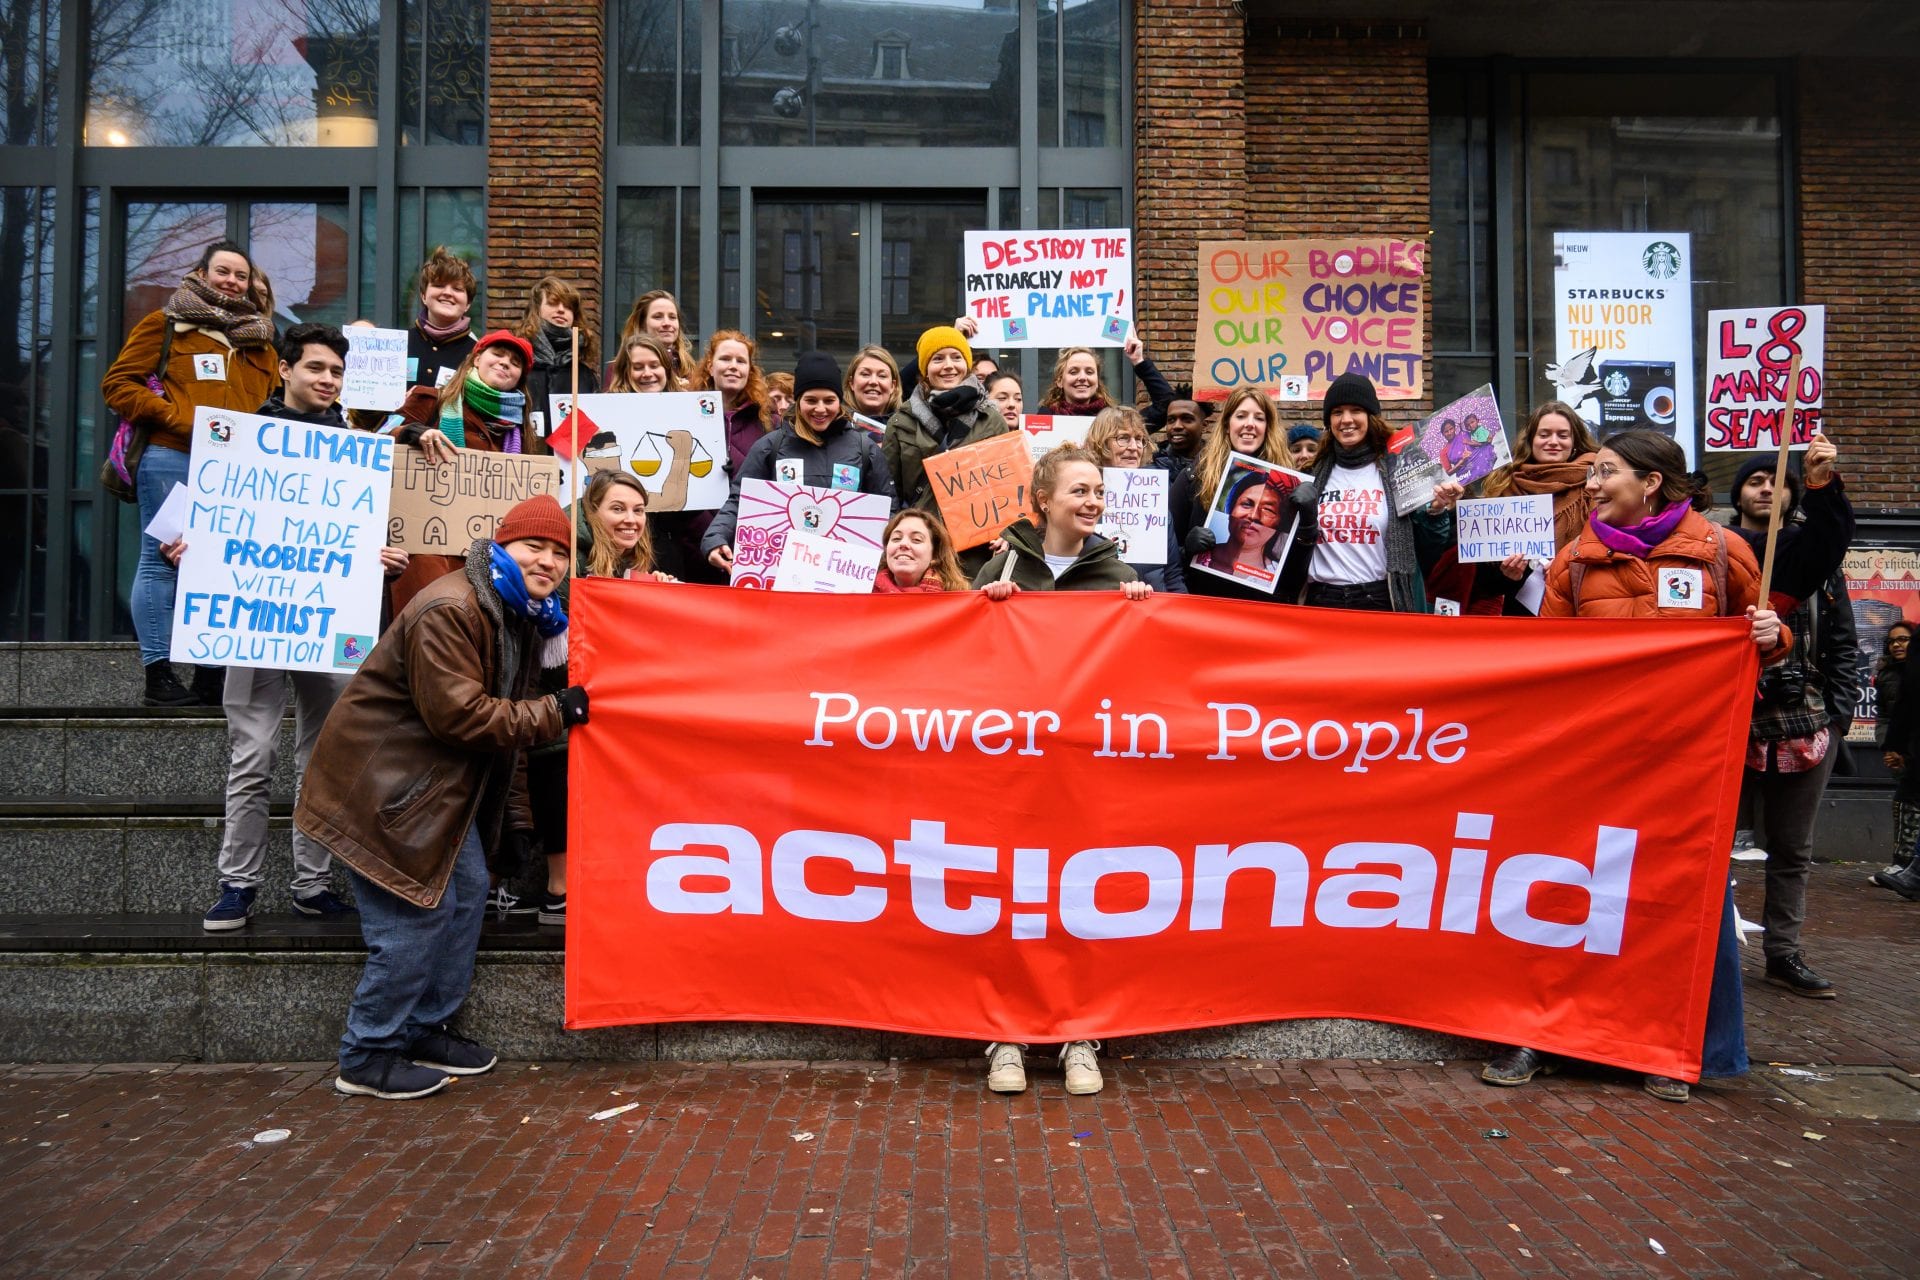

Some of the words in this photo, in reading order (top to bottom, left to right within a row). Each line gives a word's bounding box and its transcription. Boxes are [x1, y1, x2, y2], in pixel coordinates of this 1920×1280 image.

[982, 238, 1085, 270] DESTROY
[1091, 238, 1126, 258] THE
[1210, 249, 1293, 284] OUR
[1308, 242, 1425, 279] BODIES
[1566, 244, 1588, 253] NIEUW
[967, 270, 1063, 292] PATRIARCHY
[1070, 268, 1108, 289] NOT
[970, 296, 1011, 318] THE
[1209, 282, 1288, 316] OUR
[1303, 281, 1420, 315] CHOICE
[1568, 304, 1593, 325] NU
[1600, 304, 1652, 325] VOOR
[1213, 319, 1284, 346] OUR
[1302, 316, 1416, 349] VOICE
[1568, 329, 1627, 350] THUIS
[1211, 353, 1287, 386] OUR
[1305, 350, 1423, 387] PLANET
[257, 423, 392, 472] CLIMATE
[198, 460, 312, 504] CHANGE
[322, 478, 347, 507] IS
[352, 486, 373, 514] A
[936, 460, 1015, 497] WAKE
[1124, 472, 1160, 491] YOUR
[970, 485, 1026, 528] UP!
[1106, 491, 1160, 508] PLANET
[1319, 488, 1383, 505] TREAT
[1319, 502, 1379, 515] YOUR
[1511, 501, 1535, 514] THE
[190, 501, 255, 535] MEN
[281, 517, 360, 549] MADE
[423, 516, 447, 545] A
[736, 525, 768, 544] NO
[1105, 512, 1139, 525] NEEDS
[1144, 514, 1166, 531] YOU
[1319, 515, 1372, 529] GIRL
[1459, 517, 1552, 539] PATRIARCHY
[1317, 529, 1380, 544] RIGHT
[1460, 542, 1484, 558] NOT
[1488, 541, 1511, 557] THE
[1514, 540, 1554, 557] PLANET
[224, 539, 352, 577] PROBLEM
[792, 542, 822, 567] The
[826, 551, 876, 581] Future
[232, 570, 296, 597] WITH
[305, 581, 325, 603] A
[184, 592, 336, 638] FEMINIST
[189, 633, 324, 663] SOLUTION
[804, 692, 1060, 757] Power
[1093, 699, 1176, 760] in
[1206, 702, 1468, 774] People
